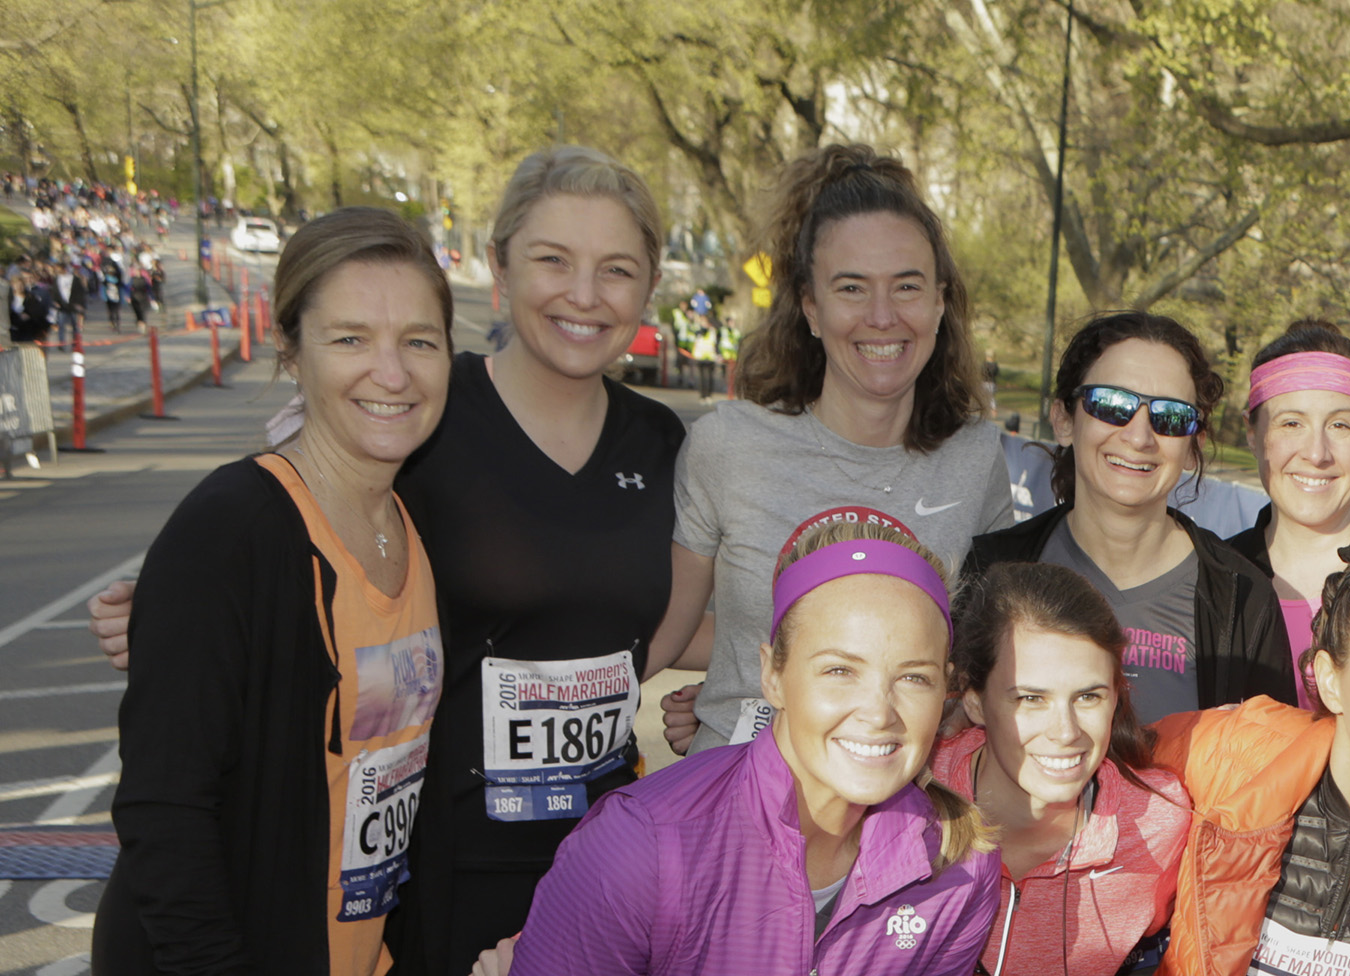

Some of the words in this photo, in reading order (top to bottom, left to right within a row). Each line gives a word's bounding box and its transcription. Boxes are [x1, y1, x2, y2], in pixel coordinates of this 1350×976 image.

[1123, 627, 1187, 654] omen's
[500, 673, 516, 710] 2016
[518, 683, 555, 700] HALF
[557, 675, 630, 701] MARATHON
[361, 767, 376, 805] 2016
[494, 797, 523, 813] 1867
[546, 795, 573, 811] 1867
[345, 898, 372, 916] 9903
